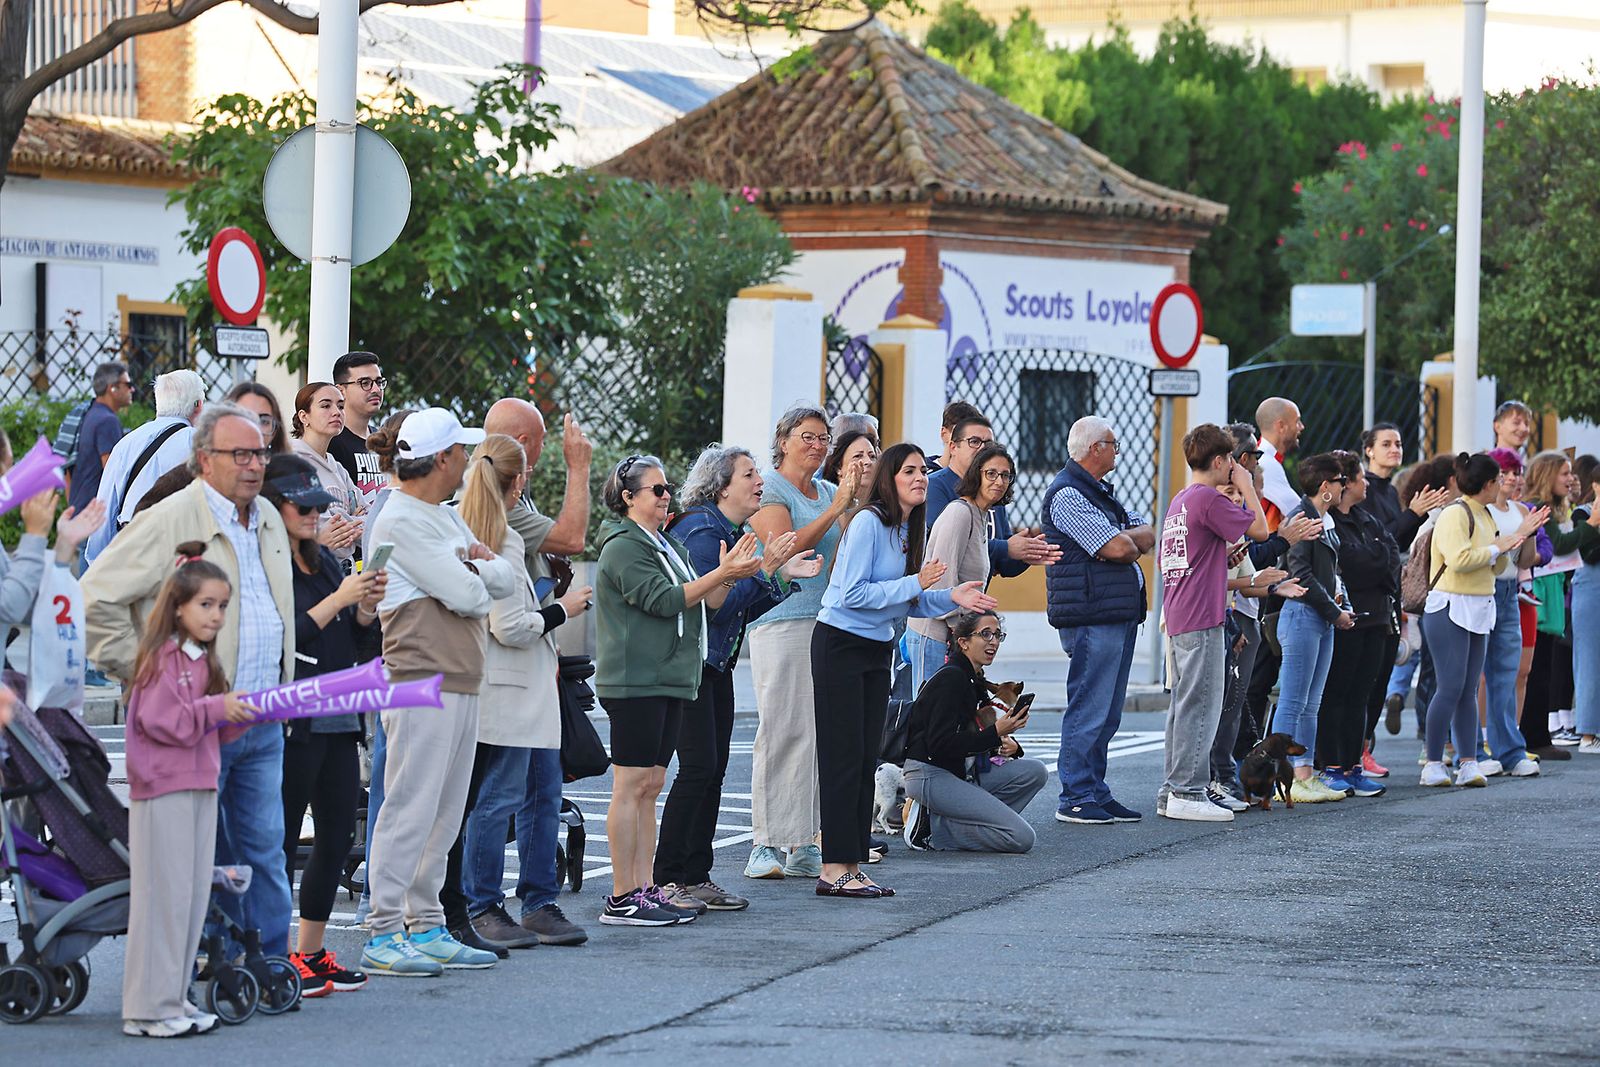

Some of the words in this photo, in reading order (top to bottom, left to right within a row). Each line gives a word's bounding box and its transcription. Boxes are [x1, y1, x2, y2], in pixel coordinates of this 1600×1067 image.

[1005, 283, 1074, 320] Scouts
[1086, 290, 1151, 325] Loyola
[241, 679, 332, 714] VATEL
